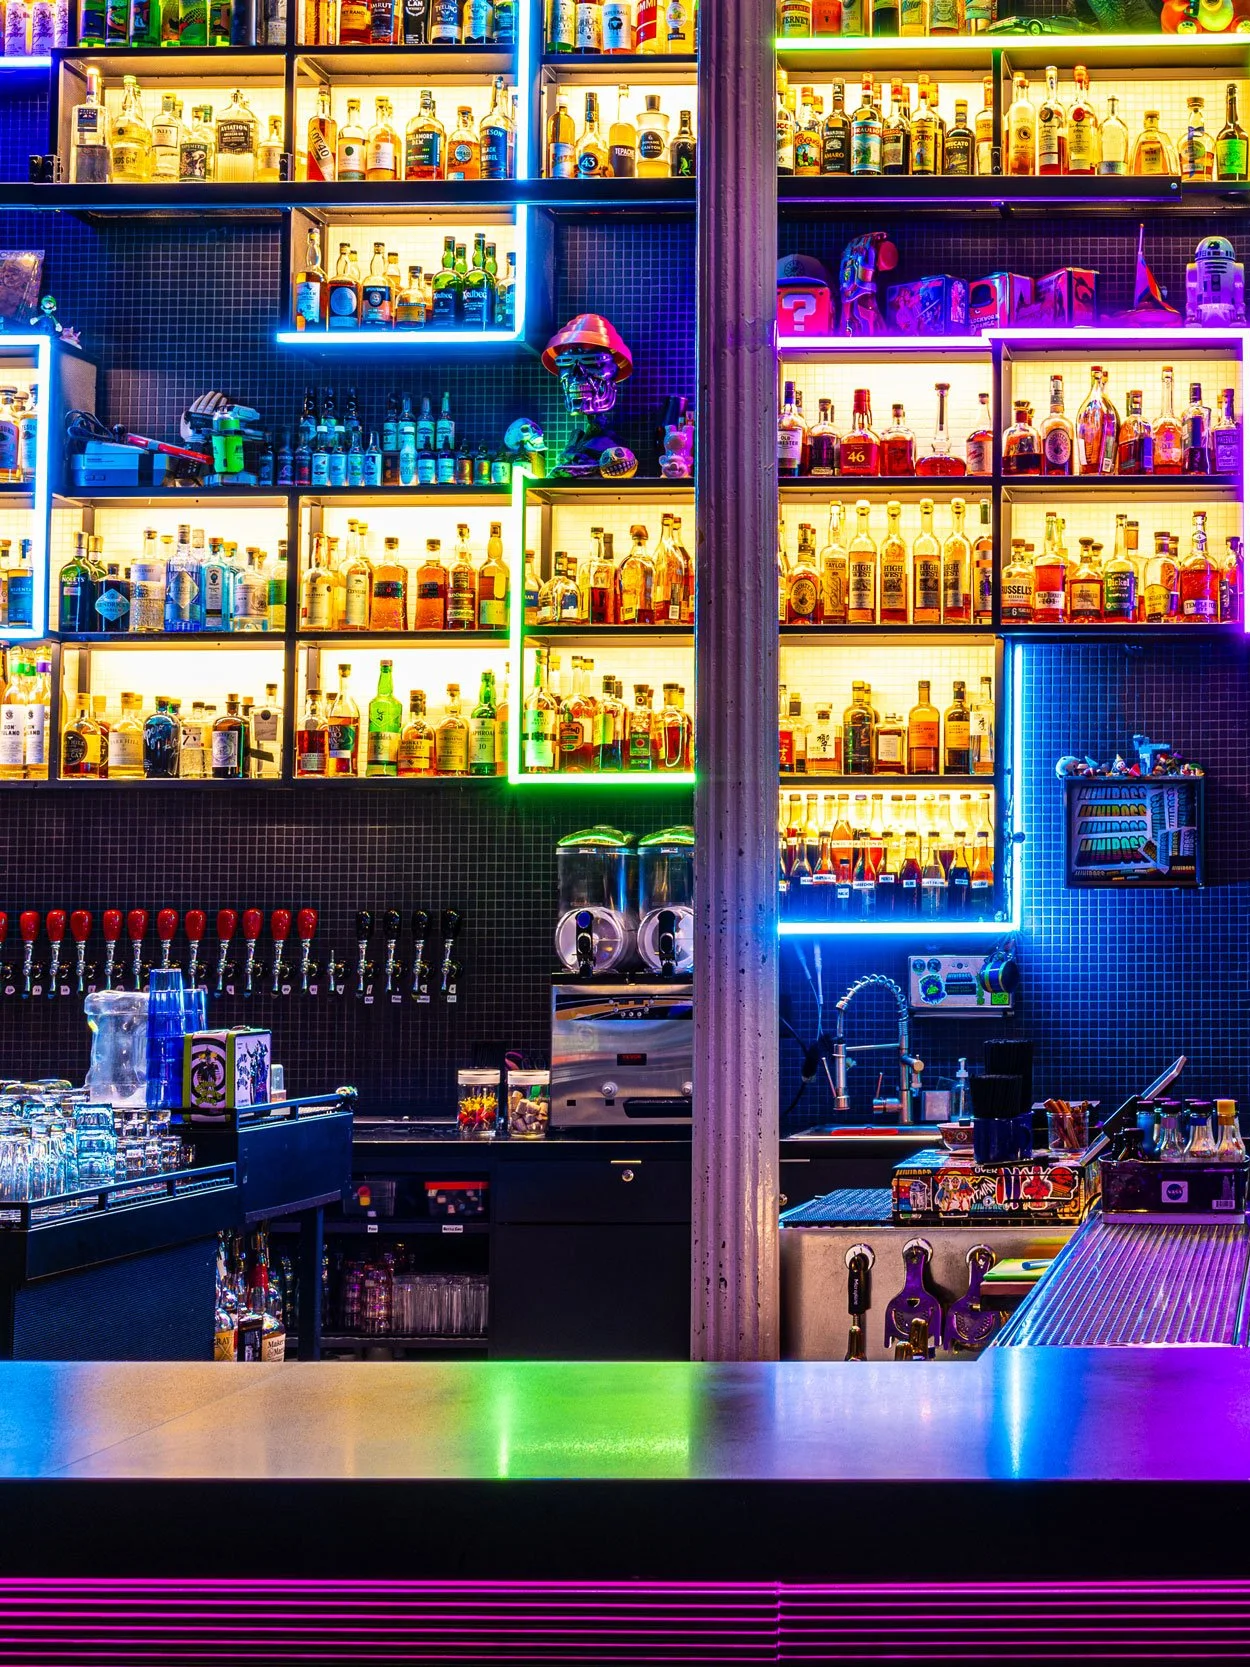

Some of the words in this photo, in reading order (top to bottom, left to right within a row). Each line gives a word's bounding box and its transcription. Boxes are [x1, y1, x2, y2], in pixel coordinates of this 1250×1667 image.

[220, 123, 249, 132] AVIATION
[824, 151, 845, 159] AMARO
[580, 156, 596, 169] 43
[847, 450, 866, 463] 46
[852, 563, 872, 571] HIGH
[884, 564, 904, 572] HIGH
[919, 563, 939, 571] HIGH
[1011, 607, 1018, 616] 6
